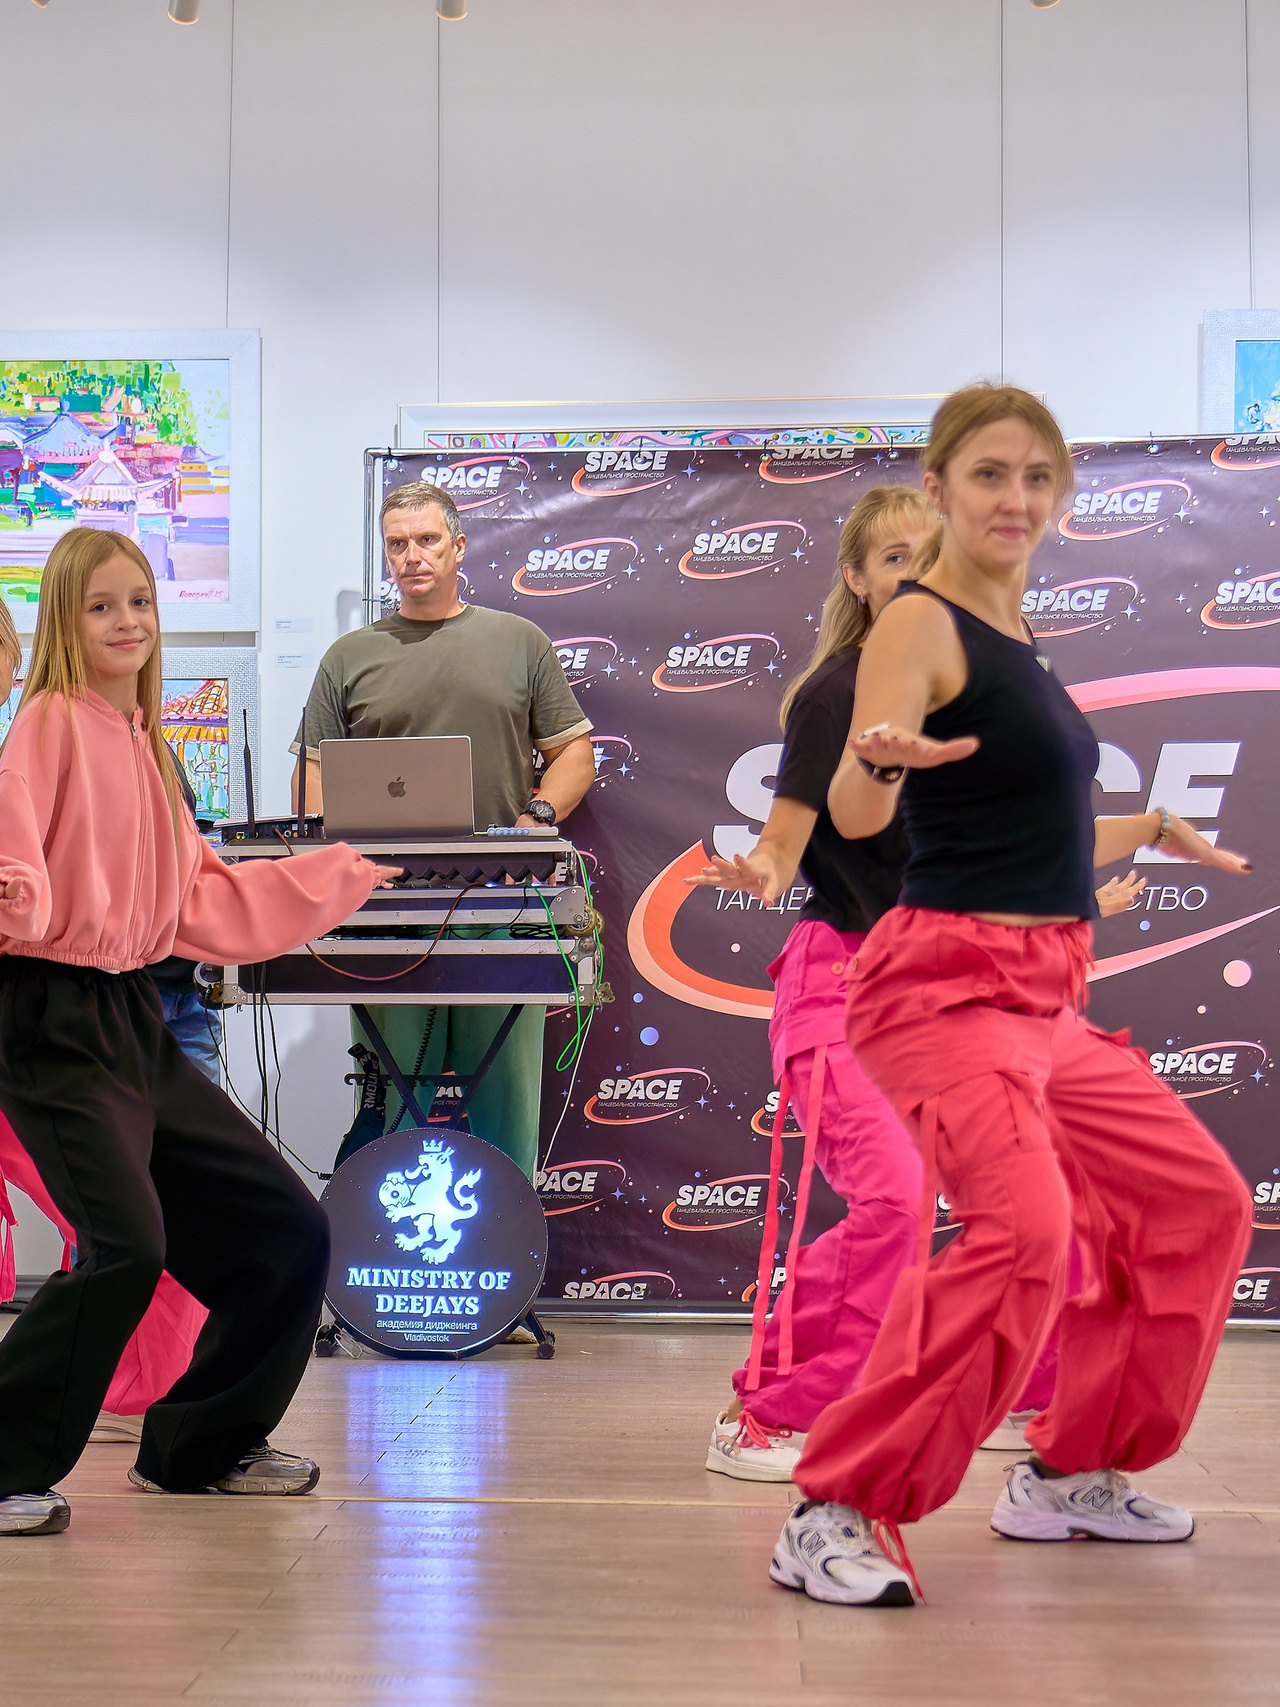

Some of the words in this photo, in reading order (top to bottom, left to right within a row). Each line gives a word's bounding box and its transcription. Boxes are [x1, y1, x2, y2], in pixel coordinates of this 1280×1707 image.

[584, 451, 668, 472] SPACE
[420, 466, 503, 488] SPACE
[1072, 492, 1162, 515] SPACE
[692, 532, 778, 554] SPACE
[525, 549, 610, 571] SPACE
[1020, 589, 1109, 612] SPACE
[1215, 582, 1280, 604] SPAC
[666, 645, 751, 667] SPACE
[1149, 1053, 1237, 1075] SPACE
[597, 1079, 682, 1100] SPACE
[535, 1171, 598, 1192] PACE
[676, 1185, 761, 1206] SPACE
[346, 1267, 476, 1289] MINISTRY
[478, 1271, 511, 1290] OF
[562, 1281, 647, 1300] SPACE
[375, 1293, 480, 1317] DEEJAYS
[376, 1319, 423, 1329] академия
[404, 1333, 449, 1342] Vladivostok
